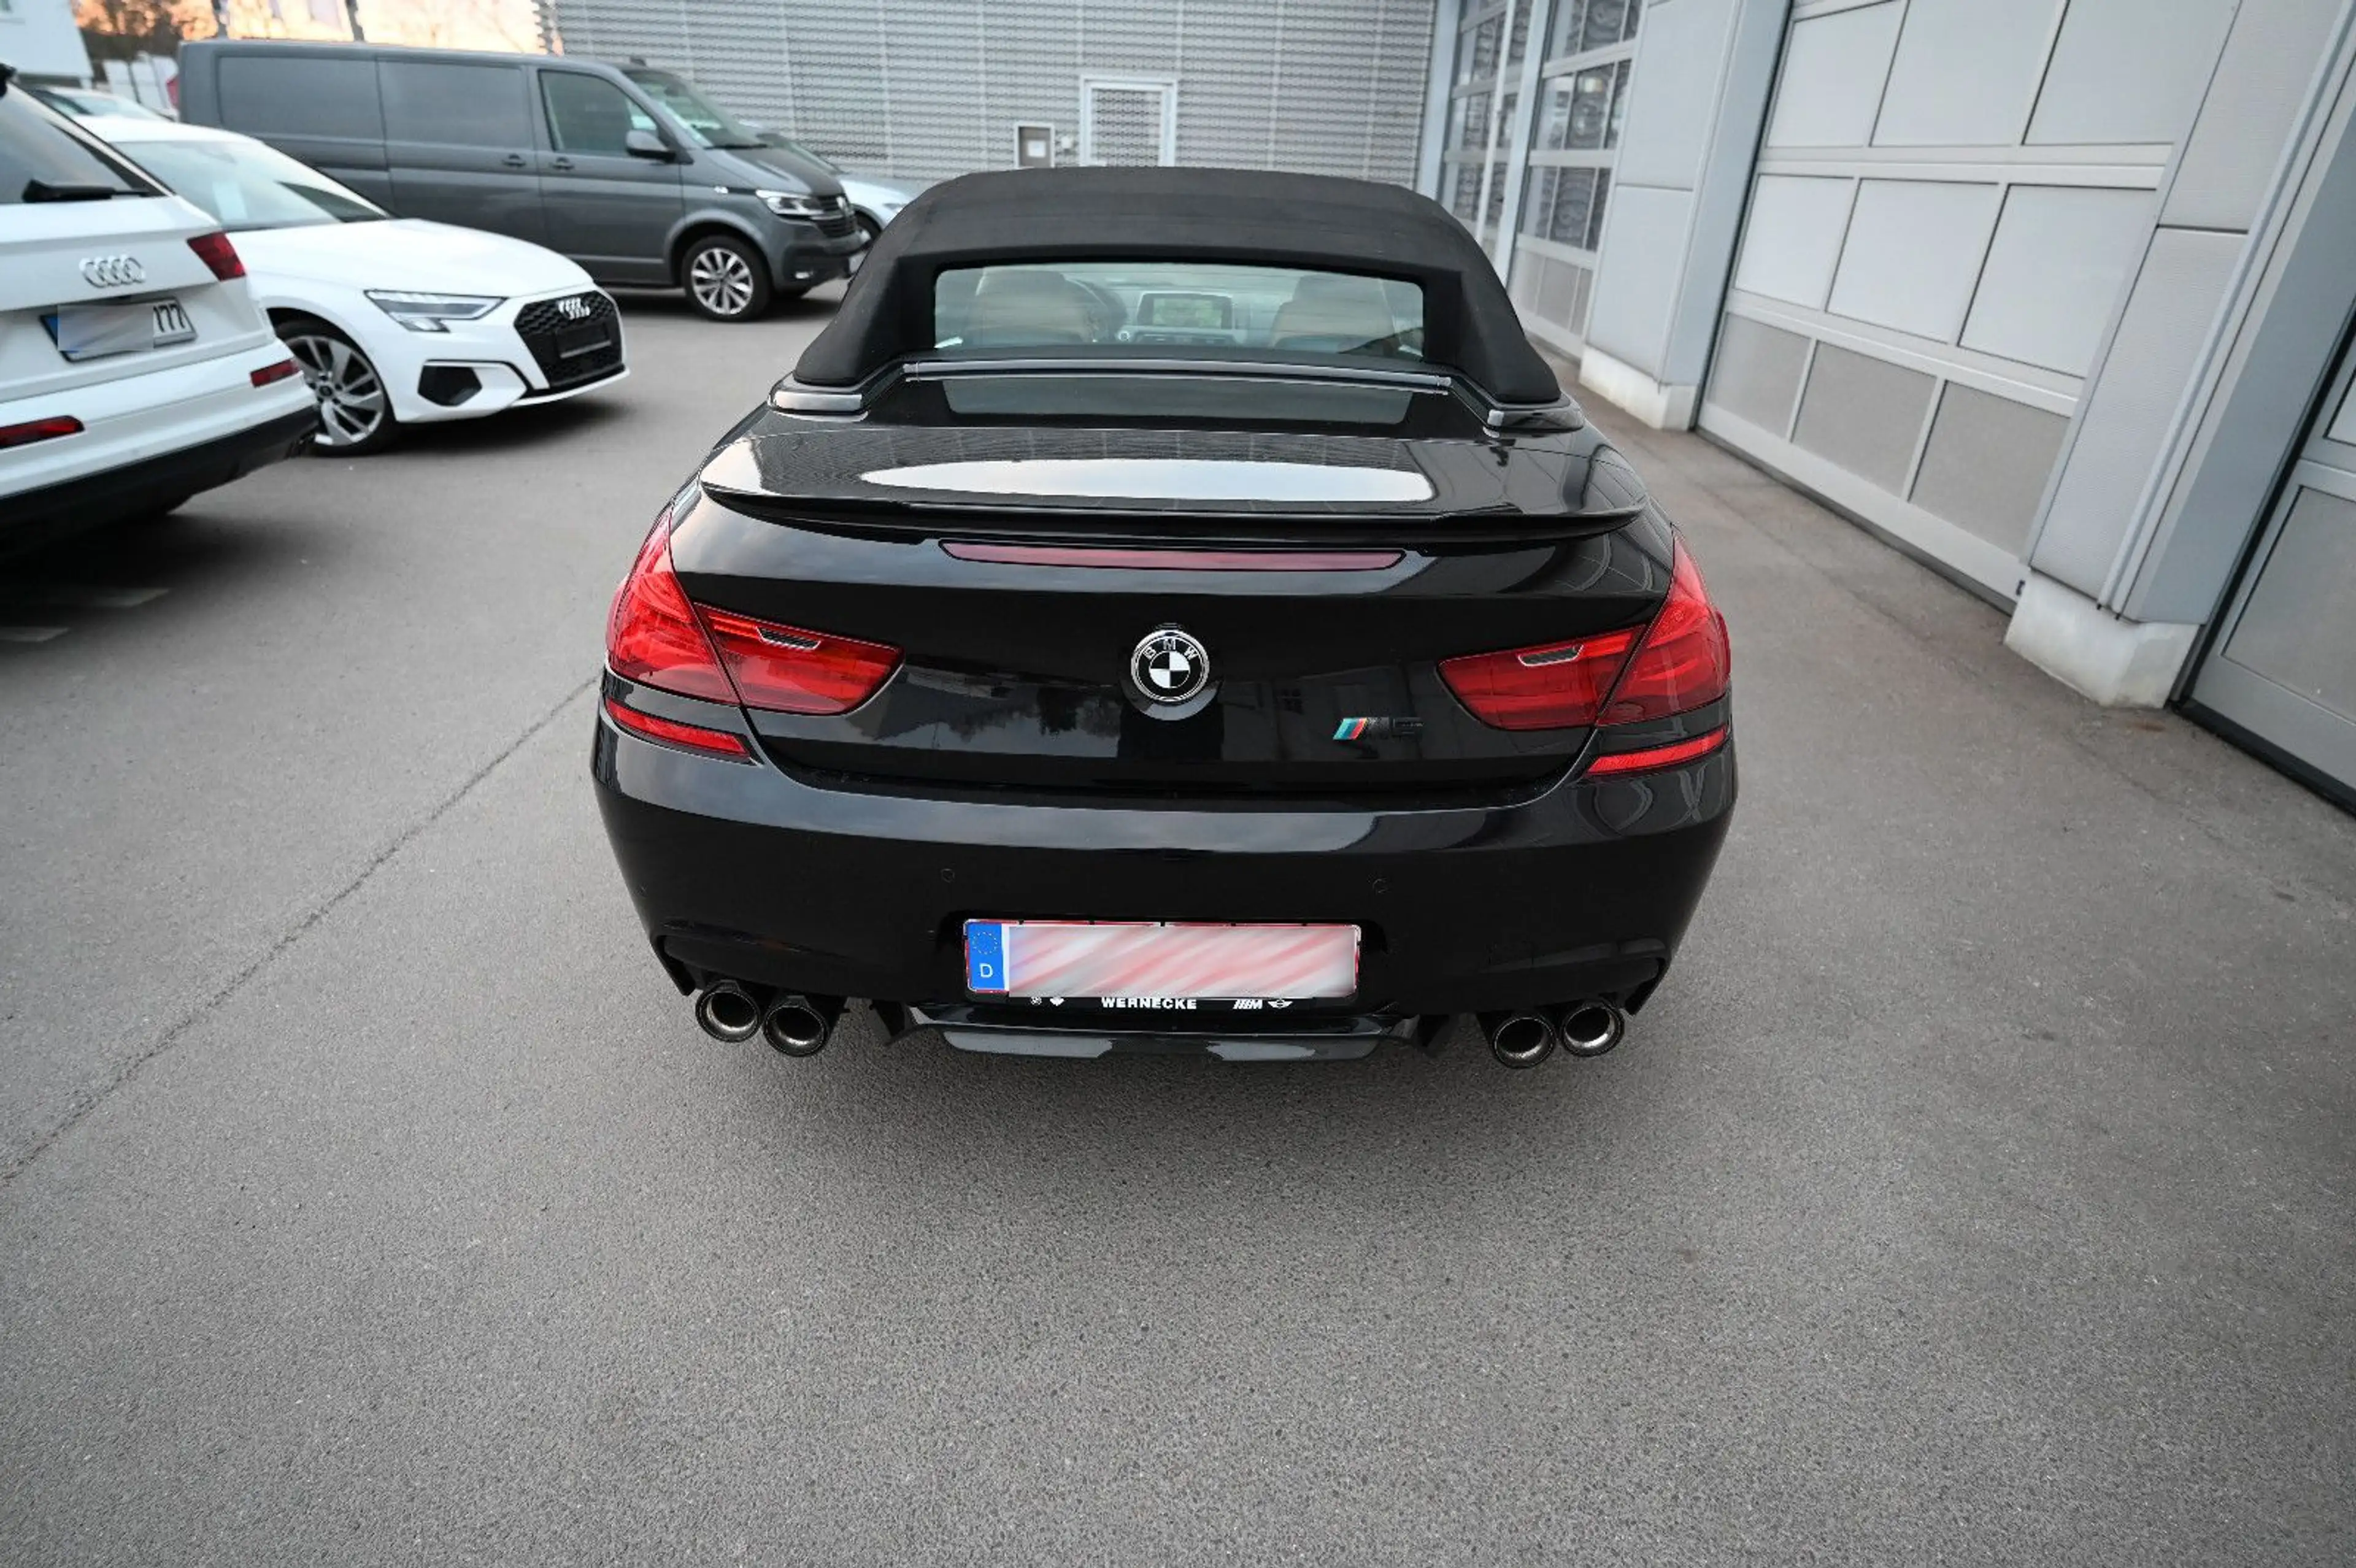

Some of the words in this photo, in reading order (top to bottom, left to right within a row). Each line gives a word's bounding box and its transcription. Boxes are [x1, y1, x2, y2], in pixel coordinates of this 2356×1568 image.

[1143, 639, 1199, 660] BMW
[979, 964, 993, 977] D
[1101, 997, 1197, 1010] WERNECKE
